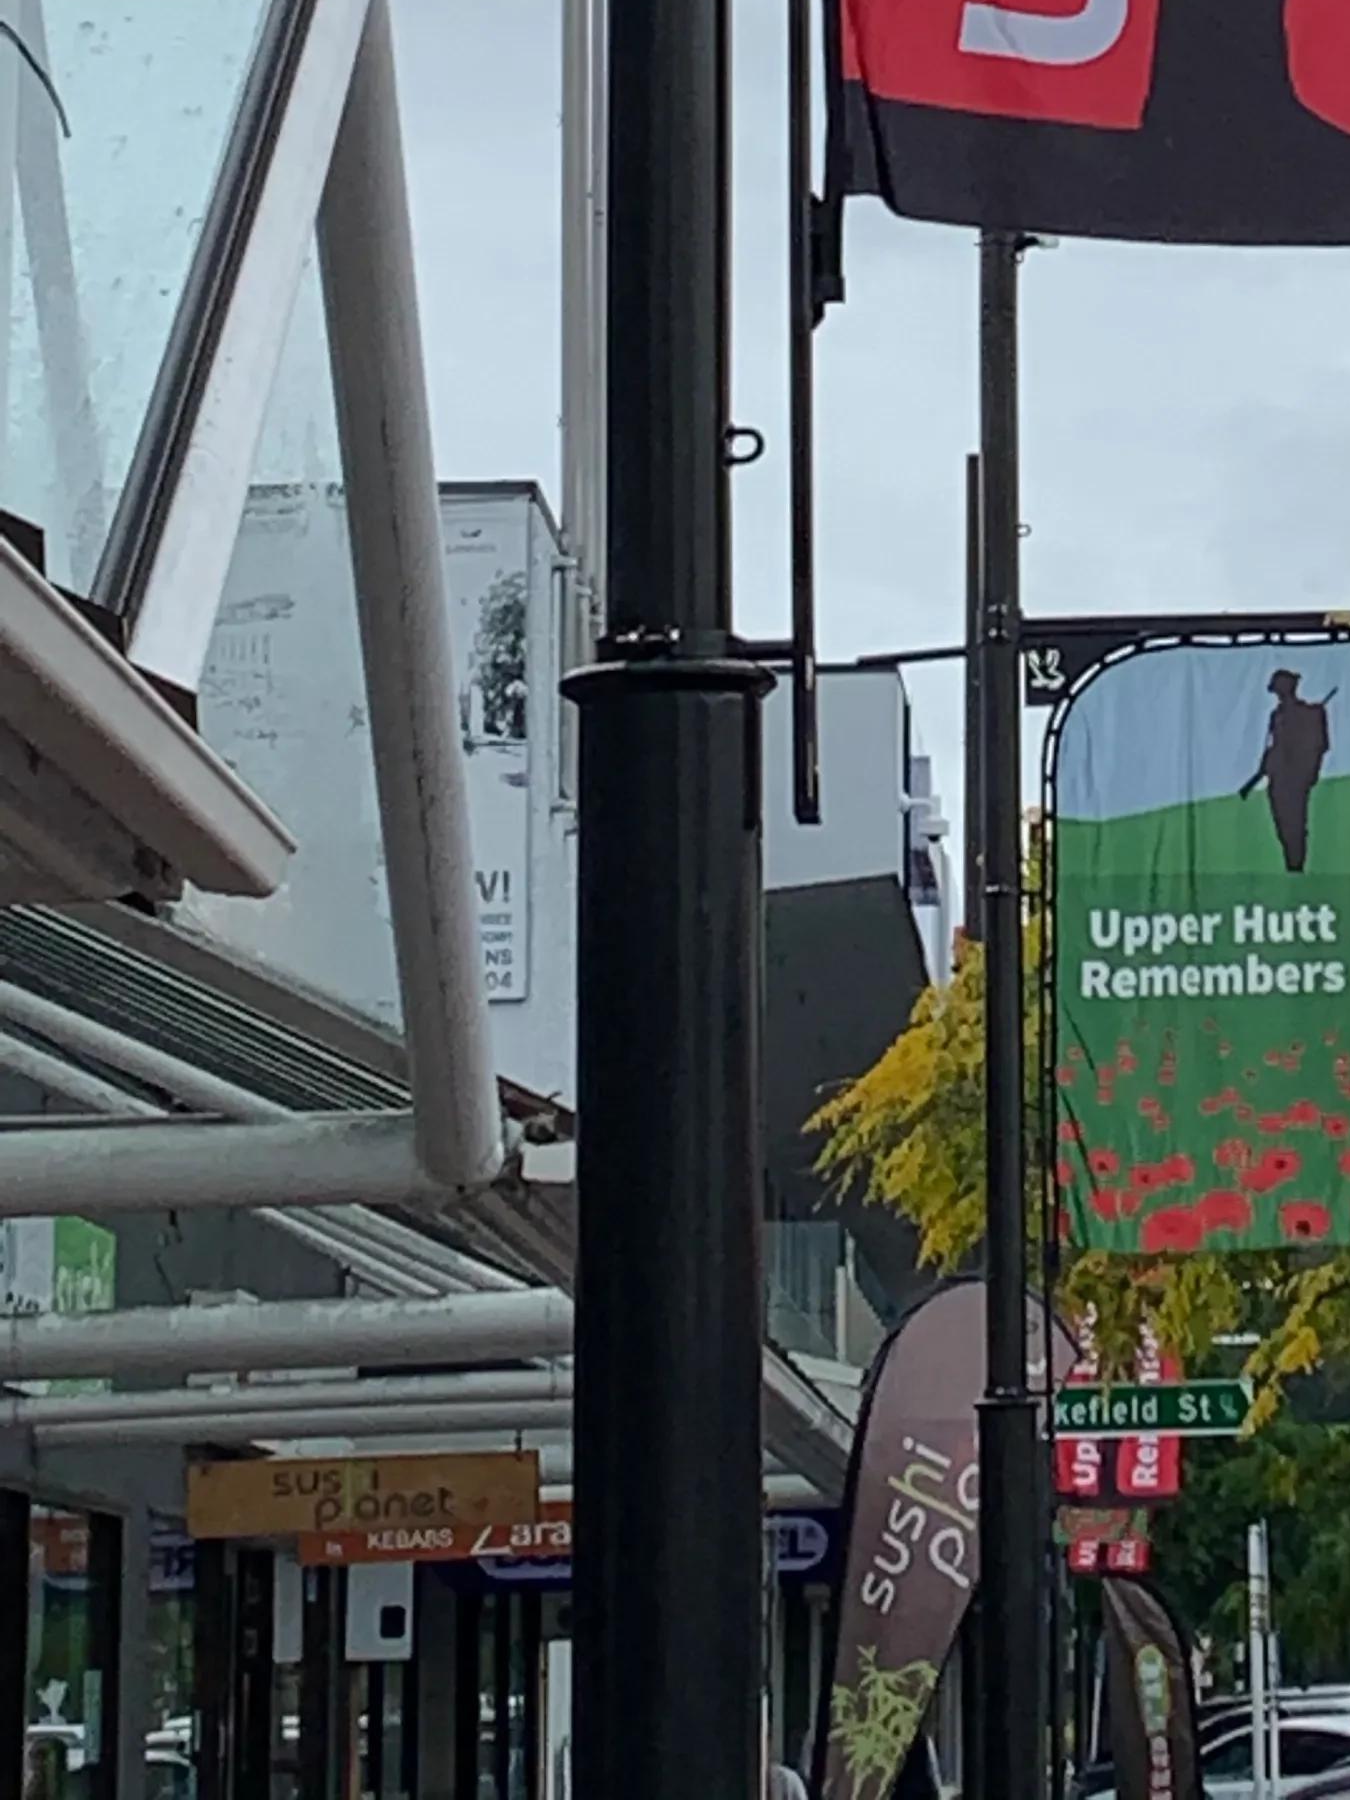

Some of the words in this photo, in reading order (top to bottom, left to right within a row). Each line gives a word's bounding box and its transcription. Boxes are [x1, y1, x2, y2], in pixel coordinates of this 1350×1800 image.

[1089, 909, 1222, 956] Upper
[1234, 904, 1336, 944] Hutt
[1080, 953, 1346, 999] Remembers
[1054, 1395, 1158, 1425] kefield
[1178, 1394, 1211, 1423] St
[367, 1528, 454, 1550] KEBABS
[861, 1436, 952, 1615] sushi
